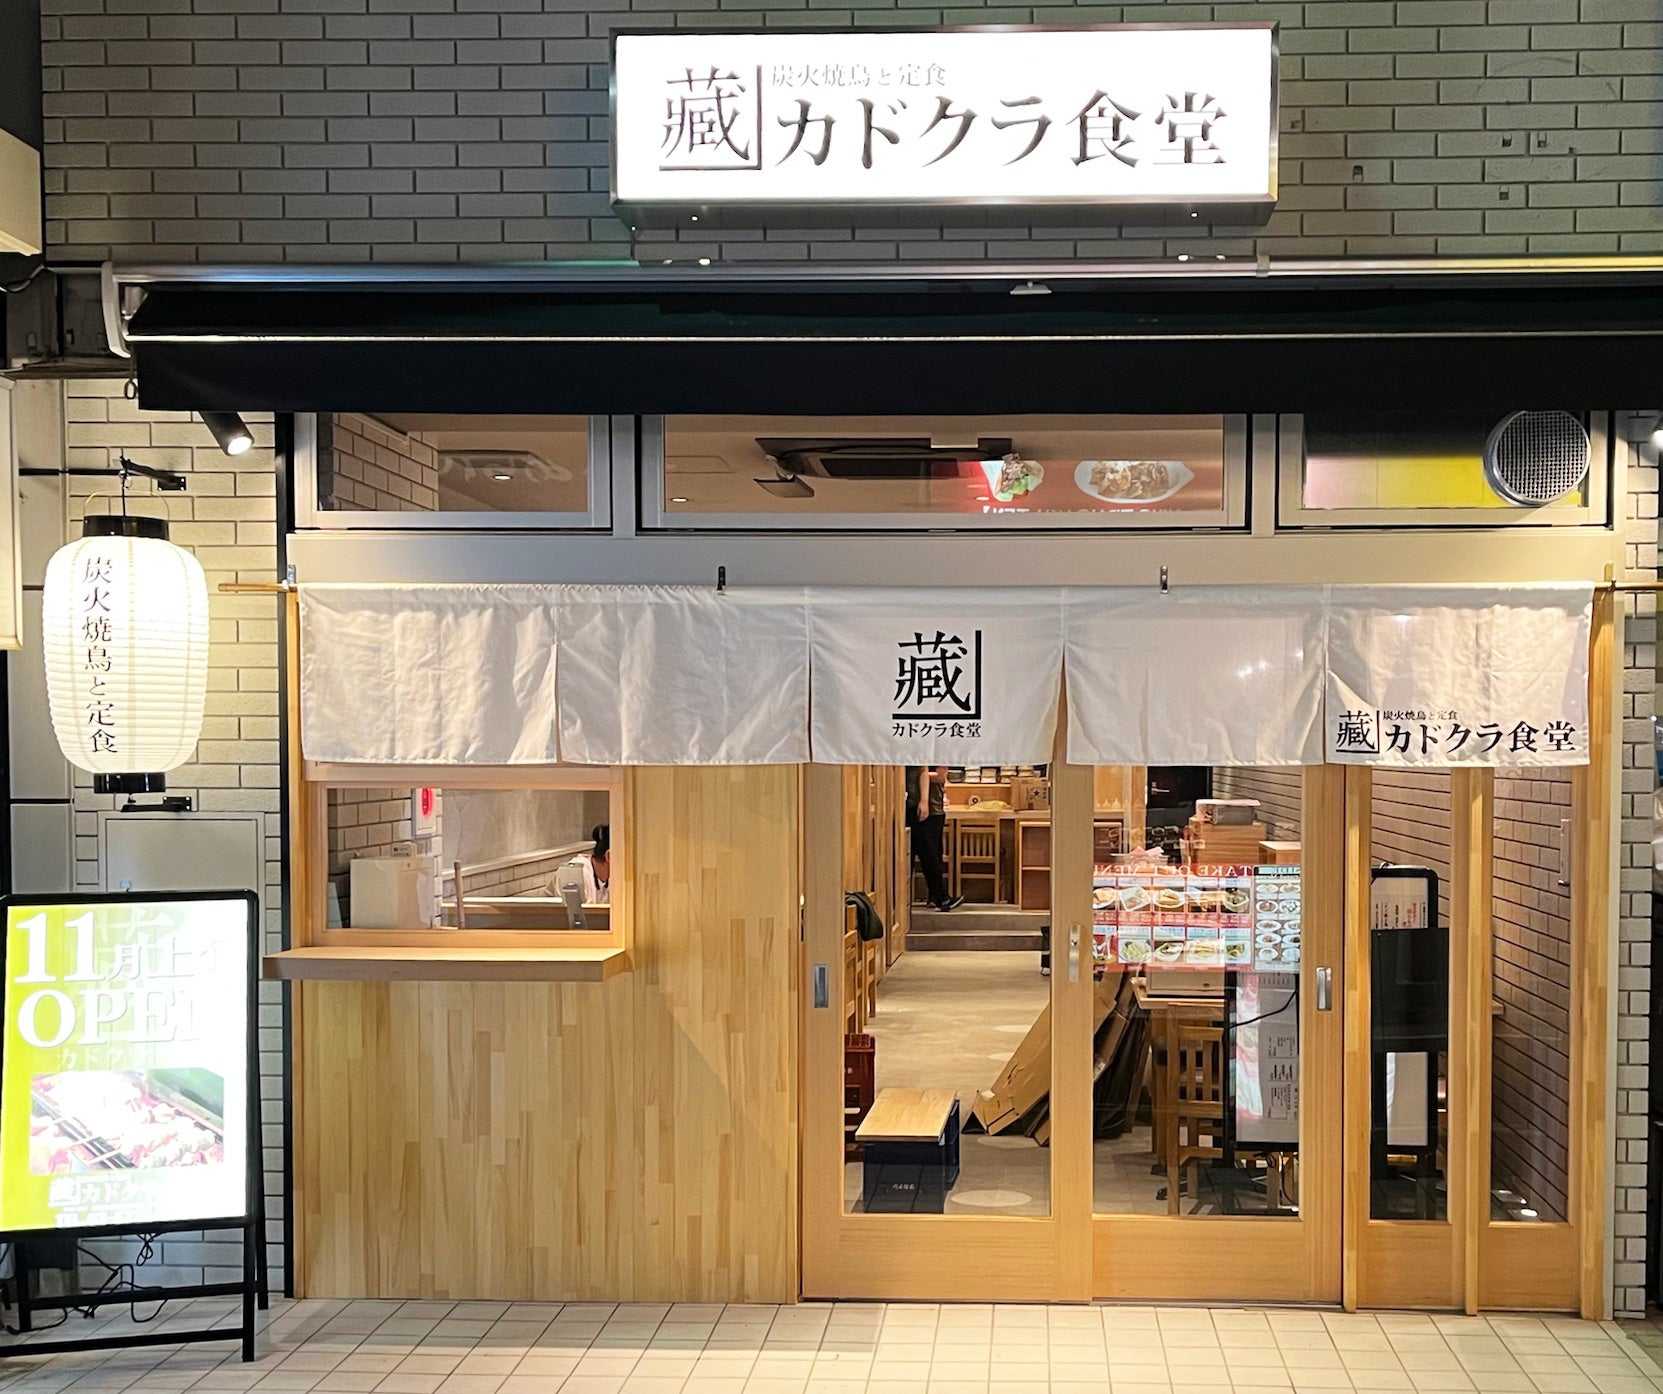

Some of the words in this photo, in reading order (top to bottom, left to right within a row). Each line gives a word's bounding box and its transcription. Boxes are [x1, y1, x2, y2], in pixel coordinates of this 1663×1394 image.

[772, 63, 947, 88] 炭火焼鳥と定食
[774, 88, 1228, 170] カドクラ食堂
[81, 556, 118, 754] 炭火焼鳥と定食
[892, 722, 982, 738] カドクラ食堂
[1382, 709, 1459, 721] 炭火焼鳥と定食
[1385, 719, 1577, 754] カドクラ食堂
